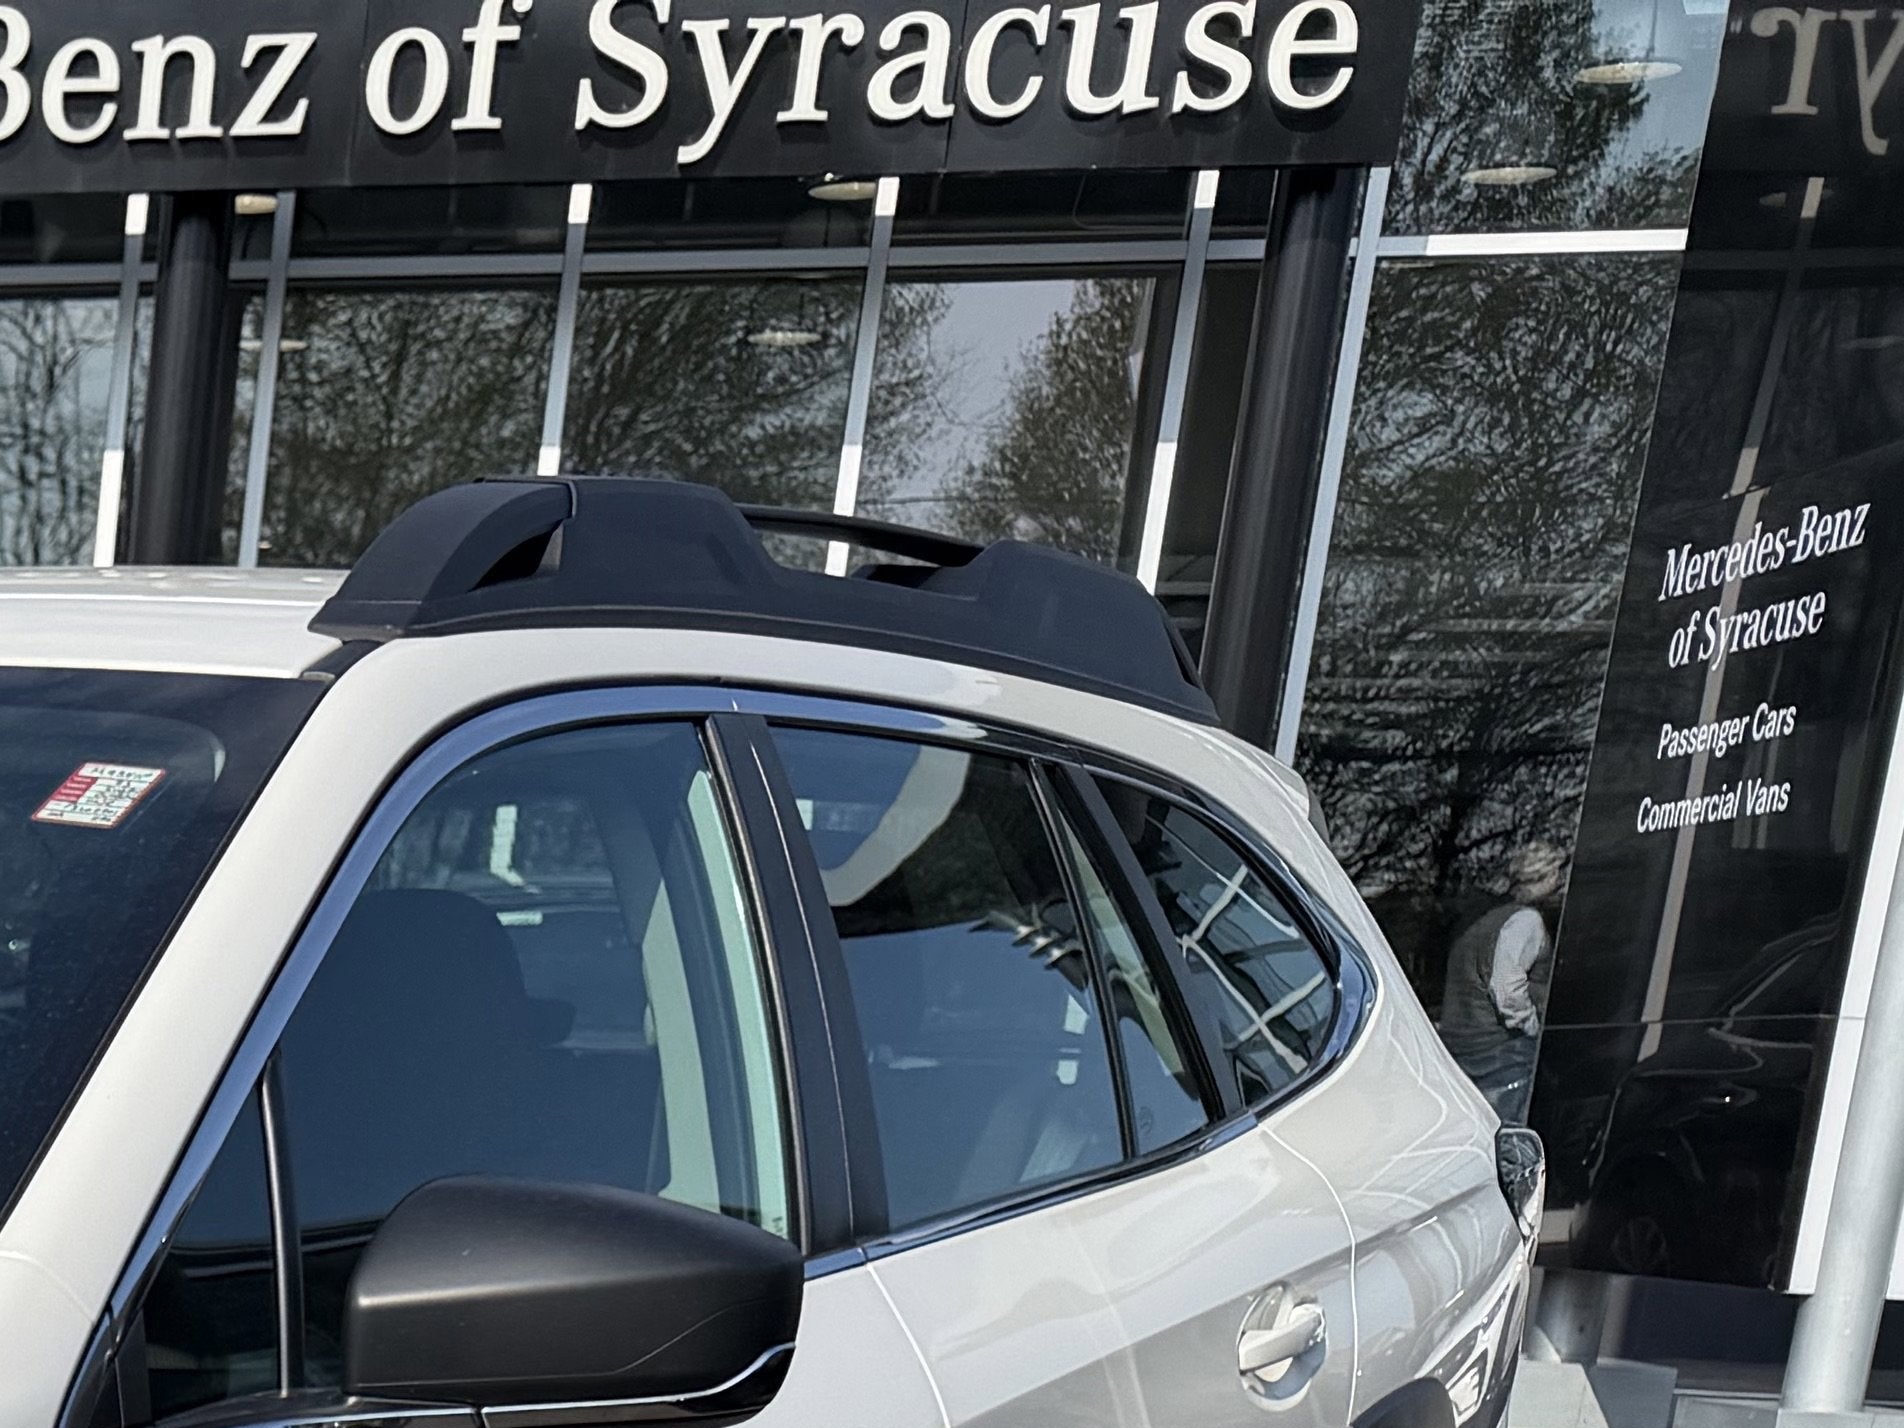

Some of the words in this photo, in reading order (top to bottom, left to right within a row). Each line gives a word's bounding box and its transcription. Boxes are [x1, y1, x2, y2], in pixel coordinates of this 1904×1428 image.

[365, 0, 532, 136] of
[573, 0, 1358, 166] Syracuse
[1658, 503, 1871, 602] Mercedes-Benz
[1669, 609, 1703, 669] of
[1698, 591, 1826, 671] Syracuse
[1657, 716, 1750, 760] Passenger
[1752, 702, 1797, 742] Cars
[1637, 780, 1743, 833] Commercial
[1745, 777, 1791, 817] Vans
